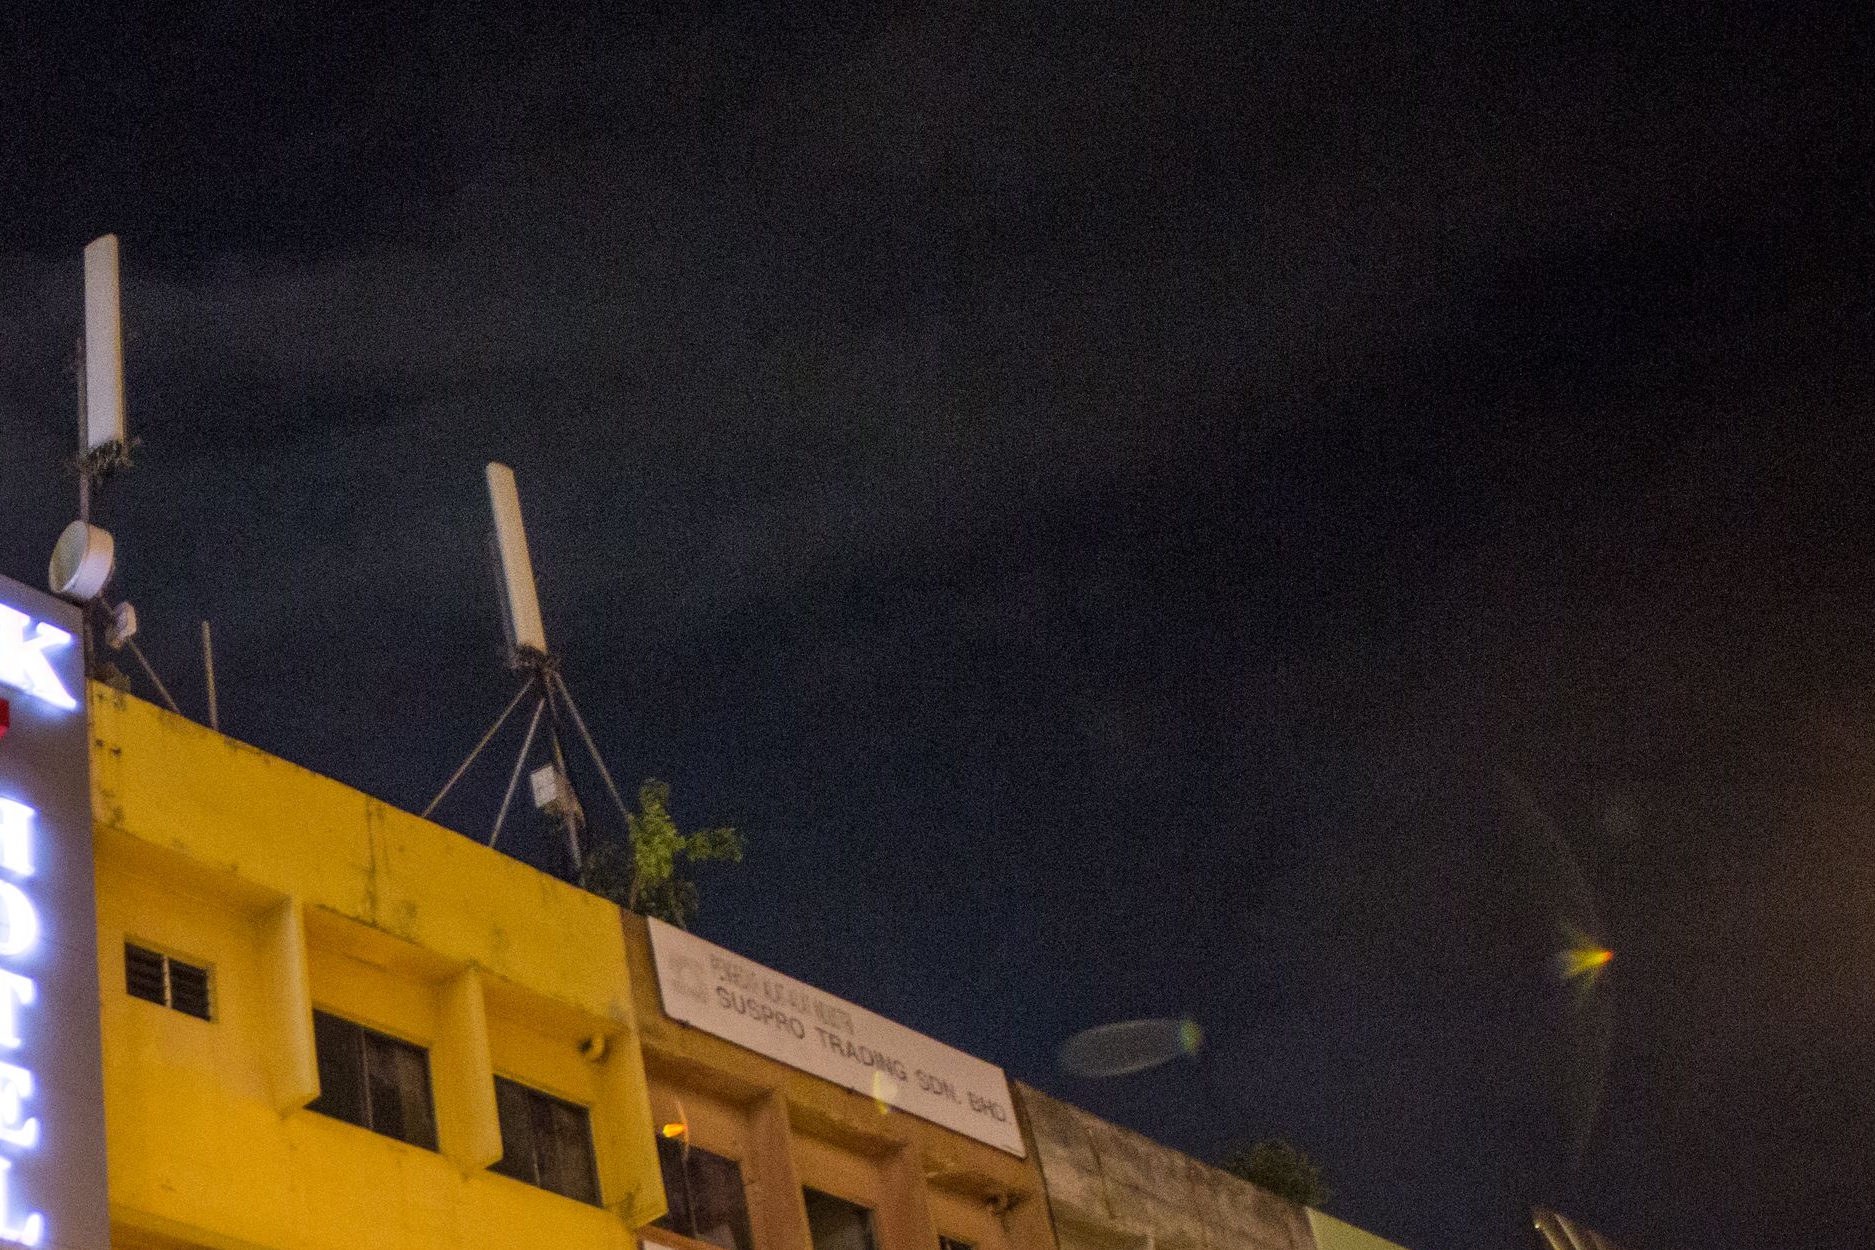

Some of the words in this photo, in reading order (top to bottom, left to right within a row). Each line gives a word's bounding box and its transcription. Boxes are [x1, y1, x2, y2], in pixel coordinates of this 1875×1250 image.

[715, 986, 806, 1041] SUSPRO
[815, 1026, 908, 1083] TRADING
[913, 1070, 962, 1105] SDN.
